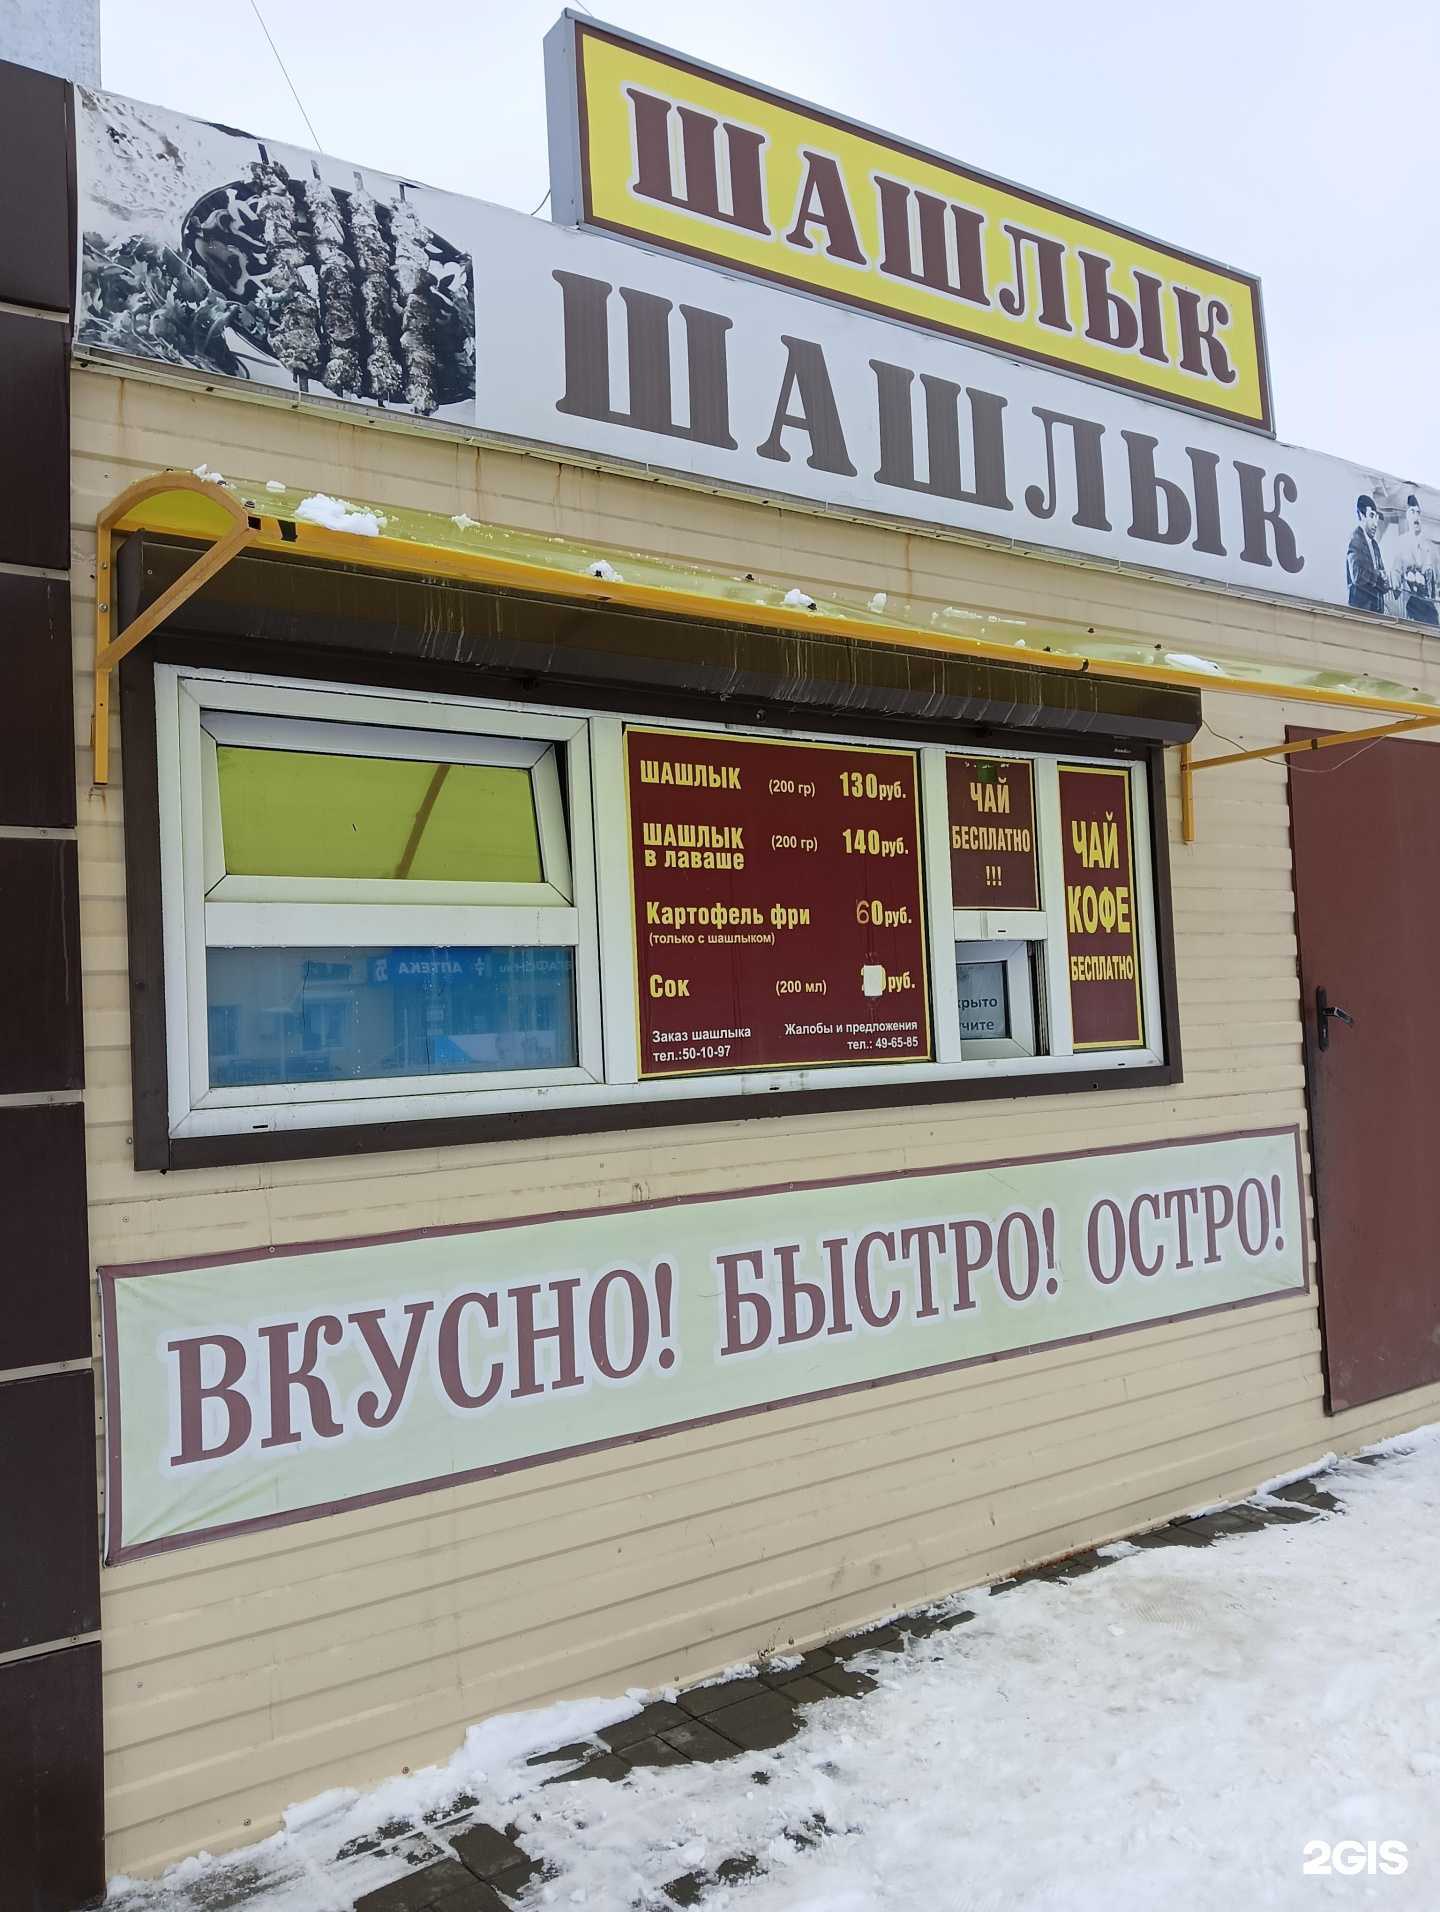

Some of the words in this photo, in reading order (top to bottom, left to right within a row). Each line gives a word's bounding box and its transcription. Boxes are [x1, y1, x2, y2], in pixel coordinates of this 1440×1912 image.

[626, 87, 1236, 384] ШАШЛЫК
[551, 269, 1305, 575] ШАШЛЫК
[640, 760, 741, 790] ШАШЛЫК
[768, 779, 795, 796] (200
[798, 782, 816, 798] гр)
[970, 777, 1011, 814] ЧАЙ
[643, 822, 745, 849] ШАШЛЫК
[771, 835, 797, 850] (200
[800, 837, 818, 852] гр)
[951, 825, 1031, 853] БЕСПЛАТНО
[1071, 811, 1120, 870] ЧАЙ
[645, 850, 657, 867] в
[664, 850, 745, 870] лаваше
[646, 901, 764, 930] Картофель
[770, 903, 811, 930] фри
[1067, 885, 1132, 934] КОФЕ
[649, 932, 695, 947] (только
[698, 935, 705, 944] с
[708, 932, 775, 947] шашлыком)
[1071, 955, 1135, 981] БЕСПЛАТНО
[650, 974, 690, 998] Сок
[775, 980, 802, 996] (200
[805, 979, 827, 995] мл)
[652, 1029, 688, 1043] Заказ
[691, 1026, 752, 1042] шашлыка
[784, 1022, 833, 1036] Жалобы
[836, 1024, 843, 1033] и
[845, 1019, 918, 1035] предложения
[847, 1039, 873, 1051] тел.:
[875, 1036, 919, 1049] 49-65-85
[167, 1262, 674, 1467] ВКУСНО!
[716, 1207, 1058, 1356] БЫСТРО!
[1087, 1174, 1286, 1286] ОСТРО!
